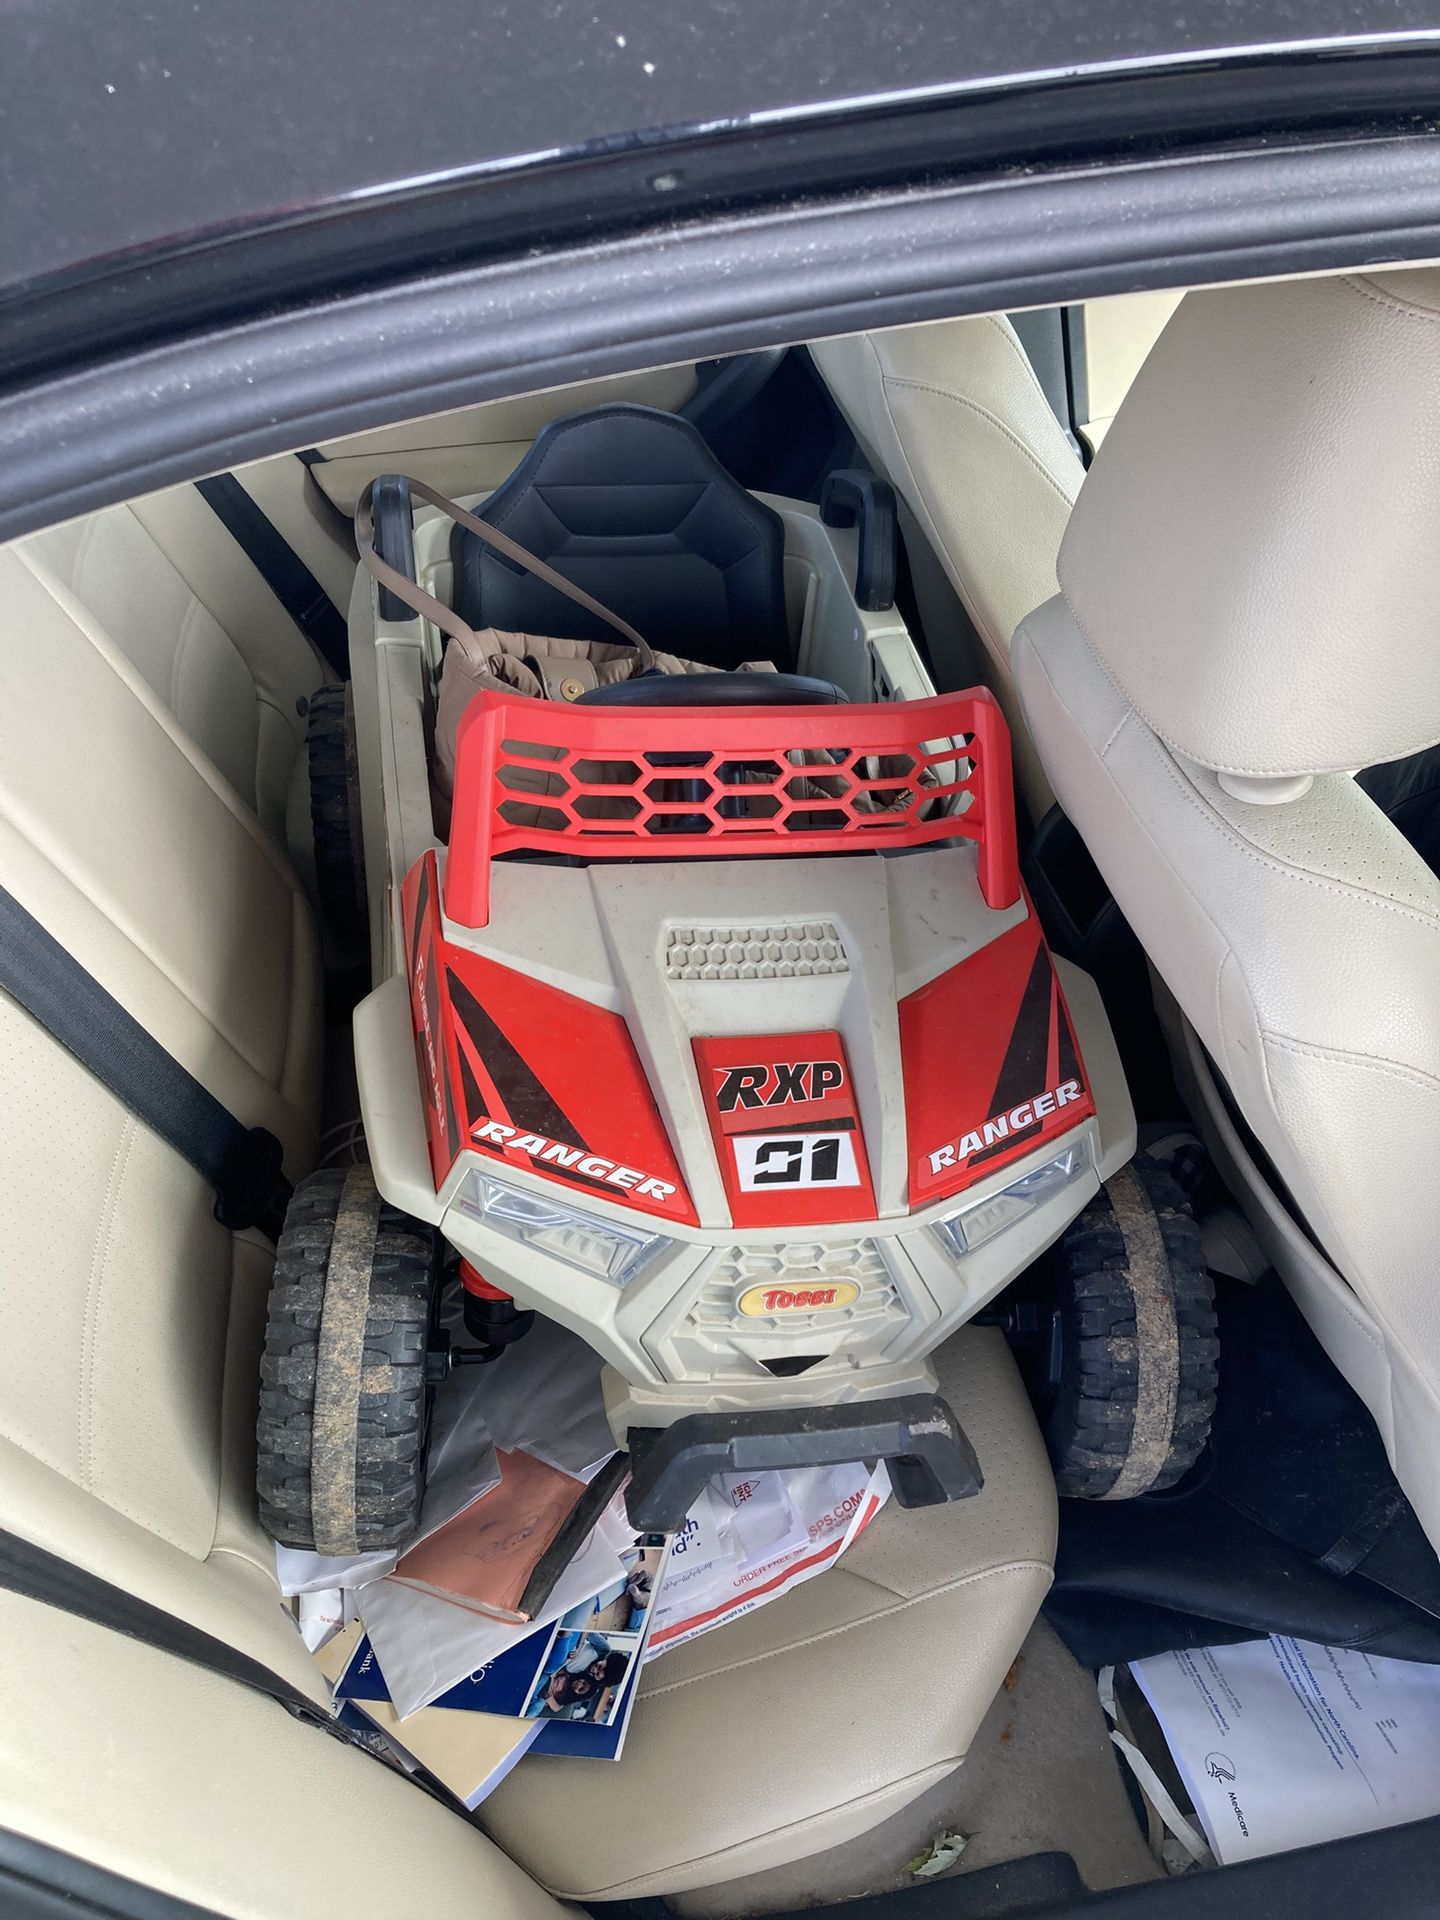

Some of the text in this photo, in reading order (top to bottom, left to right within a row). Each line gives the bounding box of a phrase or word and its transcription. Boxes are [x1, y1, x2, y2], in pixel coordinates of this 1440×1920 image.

[713, 1061, 844, 1113] RXP
[472, 1119, 677, 1201] RANGER
[928, 1079, 1085, 1175] RANGER
[808, 1487, 866, 1538] SPS.COM®
[1290, 1637, 1300, 1653] cial
[1319, 1696, 1328, 1708] for
[1326, 1708, 1340, 1729] North
[1228, 1791, 1249, 1838] Medicare
